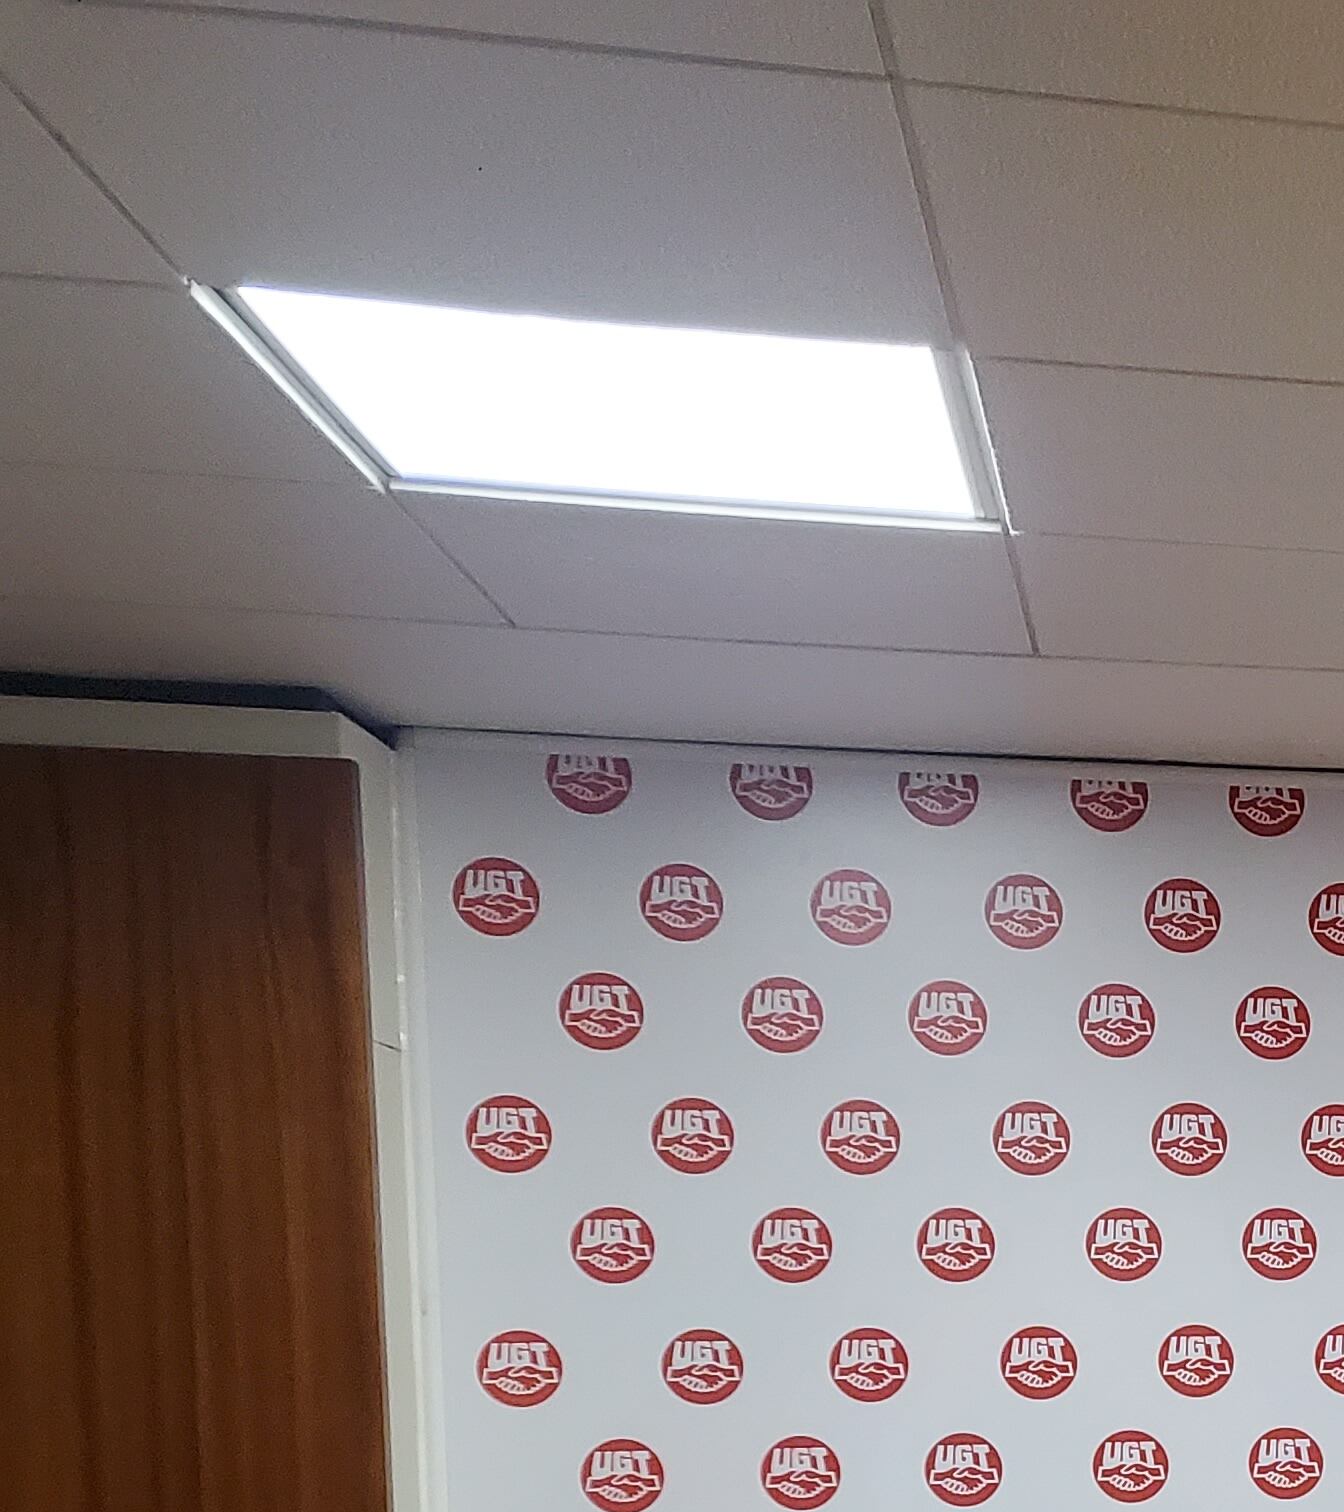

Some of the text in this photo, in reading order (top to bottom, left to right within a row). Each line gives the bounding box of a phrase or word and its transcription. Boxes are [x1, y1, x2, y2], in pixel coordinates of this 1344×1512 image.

[465, 870, 526, 898] UGT
[651, 876, 709, 903] UGT
[820, 879, 878, 907] UGT
[996, 884, 1050, 912] UGT
[1155, 889, 1209, 916] UGT
[572, 985, 630, 1012] UGT
[754, 989, 811, 1016] UGT
[920, 990, 975, 1018] UGT
[1090, 995, 1144, 1021] UGT
[1246, 997, 1299, 1024] UGT
[478, 1107, 539, 1135] UGT
[664, 1109, 722, 1137] UGT
[832, 1111, 888, 1138] UGT
[1004, 1112, 1058, 1139] UGT
[1163, 1114, 1216, 1140] UGT
[583, 1219, 643, 1246] UGT
[763, 1219, 820, 1246] UGT
[927, 1219, 983, 1246] UGT
[1097, 1218, 1150, 1245] UGT
[1252, 1219, 1305, 1245] UGT
[489, 1342, 550, 1369] UGT
[673, 1340, 731, 1368] UGT
[841, 1339, 898, 1366] UGT
[1011, 1337, 1066, 1364] UGT
[1169, 1335, 1222, 1361] UGT
[592, 1450, 652, 1477] UGT
[771, 1447, 828, 1474] UGT
[935, 1444, 991, 1471] UGT
[1103, 1440, 1157, 1467] UGT
[1258, 1439, 1311, 1465] UGT
